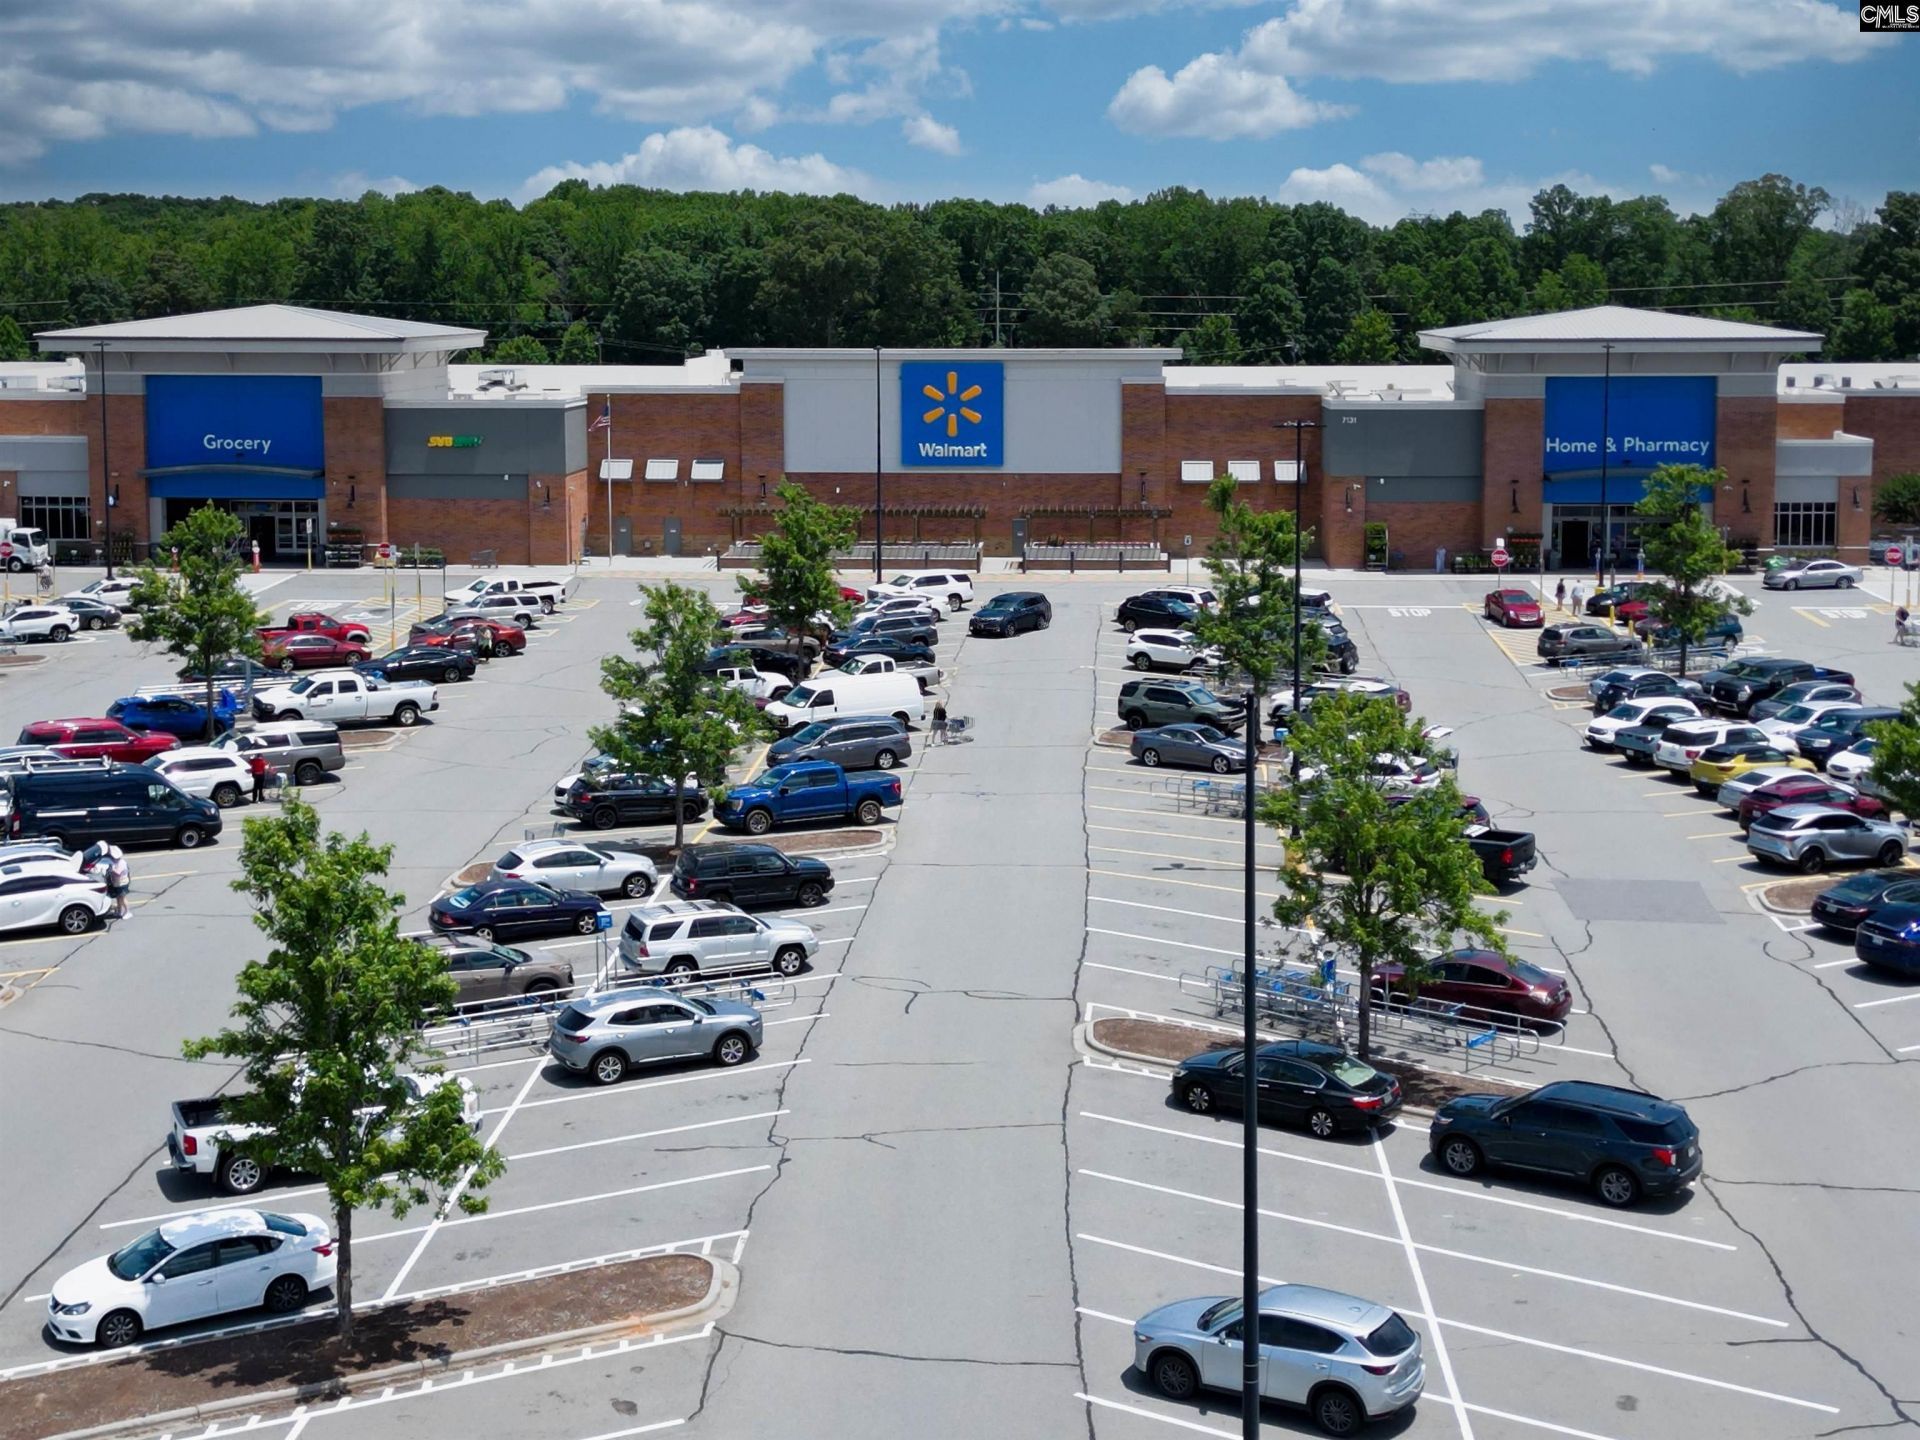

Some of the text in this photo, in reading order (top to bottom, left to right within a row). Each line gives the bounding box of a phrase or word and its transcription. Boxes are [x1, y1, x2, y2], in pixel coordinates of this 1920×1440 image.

[203, 434, 271, 454] Grocery
[918, 442, 987, 457] Walmart
[1545, 436, 1710, 456] Home & Pharmacy
[1387, 608, 1432, 616] STOP
